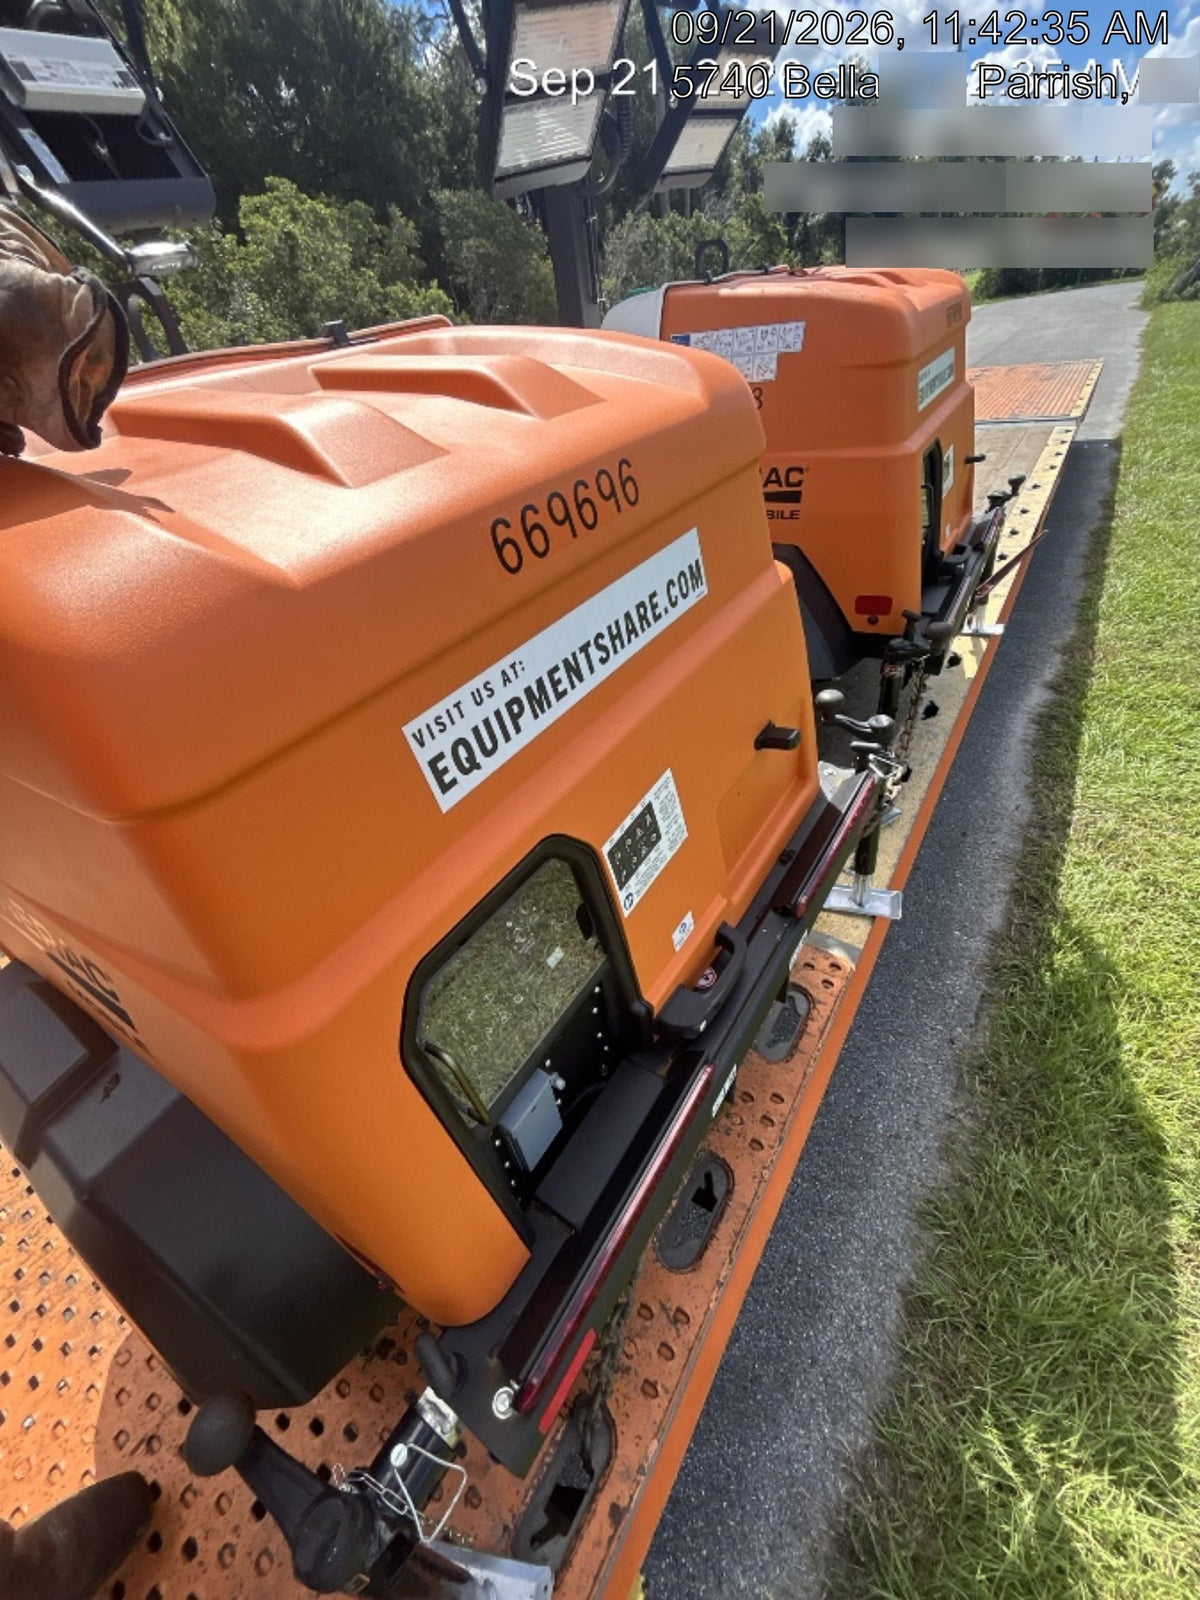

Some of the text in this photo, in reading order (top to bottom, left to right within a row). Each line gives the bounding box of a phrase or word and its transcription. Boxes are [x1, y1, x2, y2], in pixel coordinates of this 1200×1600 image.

[490, 458, 640, 575] 669696
[759, 466, 804, 488] AC
[411, 659, 527, 749] VISIT US AT:
[427, 558, 704, 796] EQUIPMENTSHARE.COM
